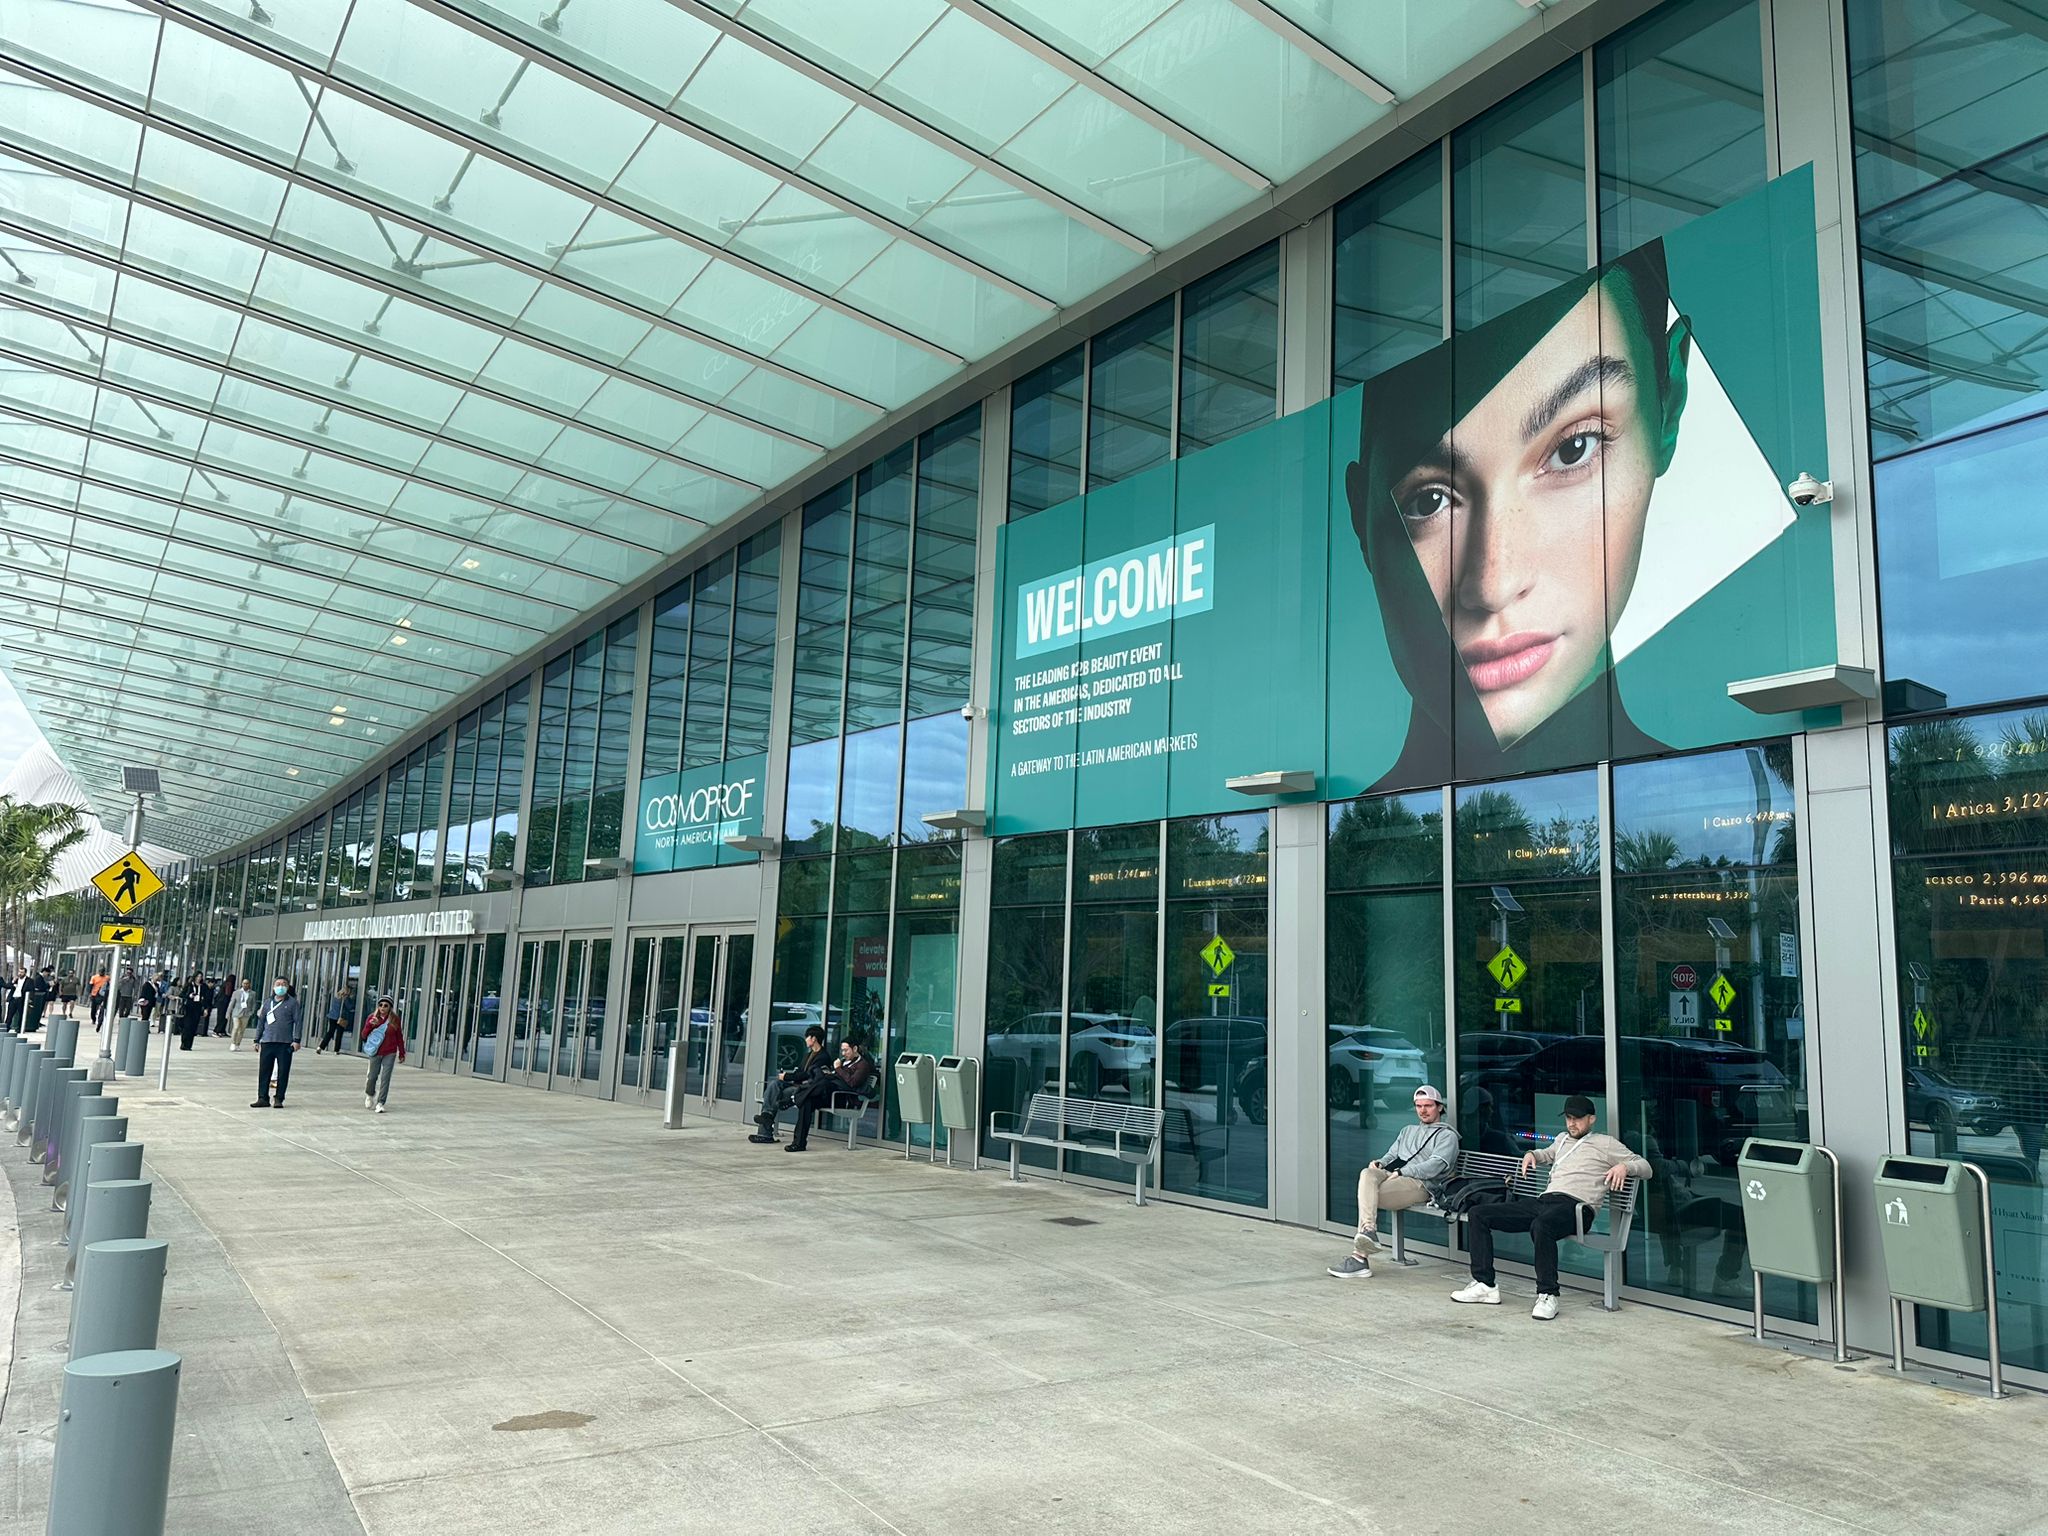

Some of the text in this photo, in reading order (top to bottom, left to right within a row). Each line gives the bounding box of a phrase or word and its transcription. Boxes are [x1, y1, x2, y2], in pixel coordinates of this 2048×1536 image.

[1026, 538, 1205, 644] WELCOME
[1015, 674, 1031, 691] THE
[1032, 664, 1070, 688] LEADING
[1091, 650, 1129, 674] BEAUTY
[1130, 642, 1163, 665] EVENT
[1014, 662, 1183, 713] IN THE AMERICAS, DEDICATED TO ALL
[1013, 697, 1132, 735] SECTORS OF THE INDUSTRY
[1011, 732, 1198, 777] A GATEWAY TO THE LATIN AMERICAN MARKETS
[646, 778, 756, 830] COSMOPROF
[1945, 800, 1995, 818] Arica
[1712, 815, 1742, 827] Cairo
[1745, 811, 1775, 825] 6,478
[655, 836, 679, 848] NORTH
[680, 830, 713, 845] AMERICA
[1515, 848, 1533, 859] Cluj
[1188, 876, 1233, 888] Luxembourg
[1983, 872, 2028, 886] 2,596
[1970, 894, 2048, 906] Paris 4,565
[303, 909, 475, 941] MIAMI BEACH CONVENTION CENTER
[859, 941, 885, 954] elevate
